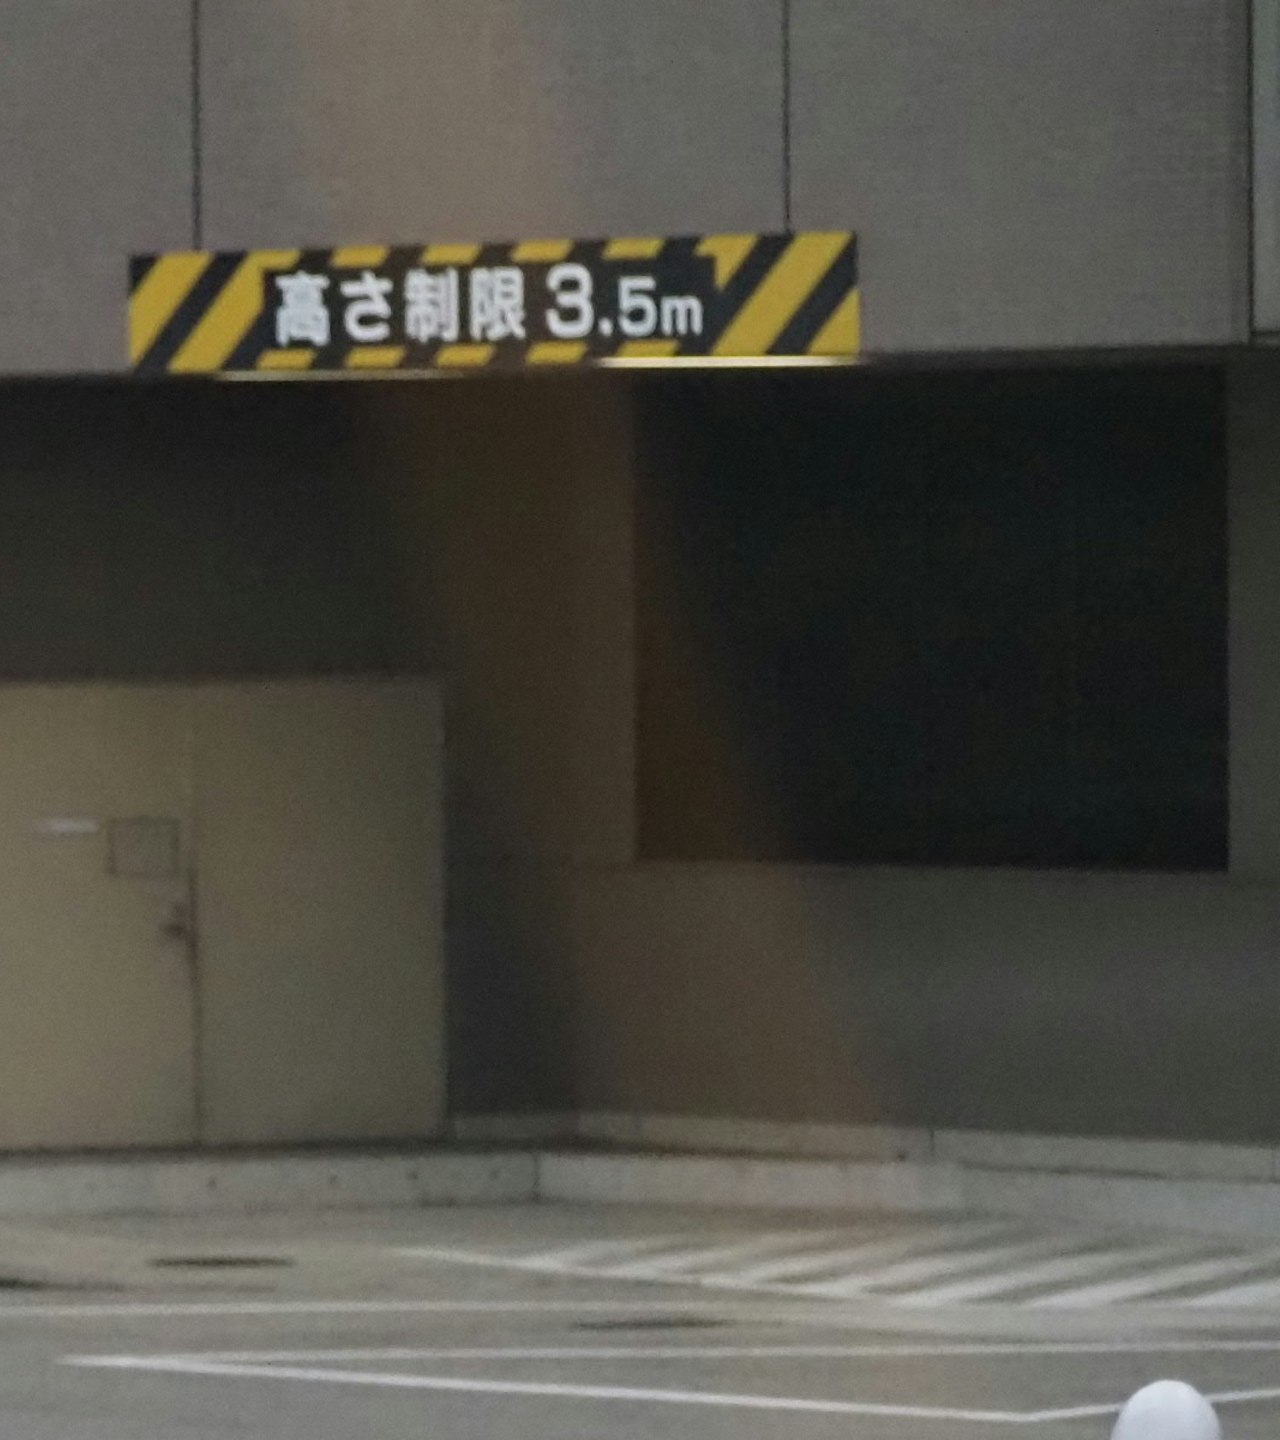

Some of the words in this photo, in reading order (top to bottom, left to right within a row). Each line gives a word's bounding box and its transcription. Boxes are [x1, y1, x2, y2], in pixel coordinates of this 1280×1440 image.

[274, 268, 525, 346] 高さ制限
[545, 263, 704, 339] 3.5m
